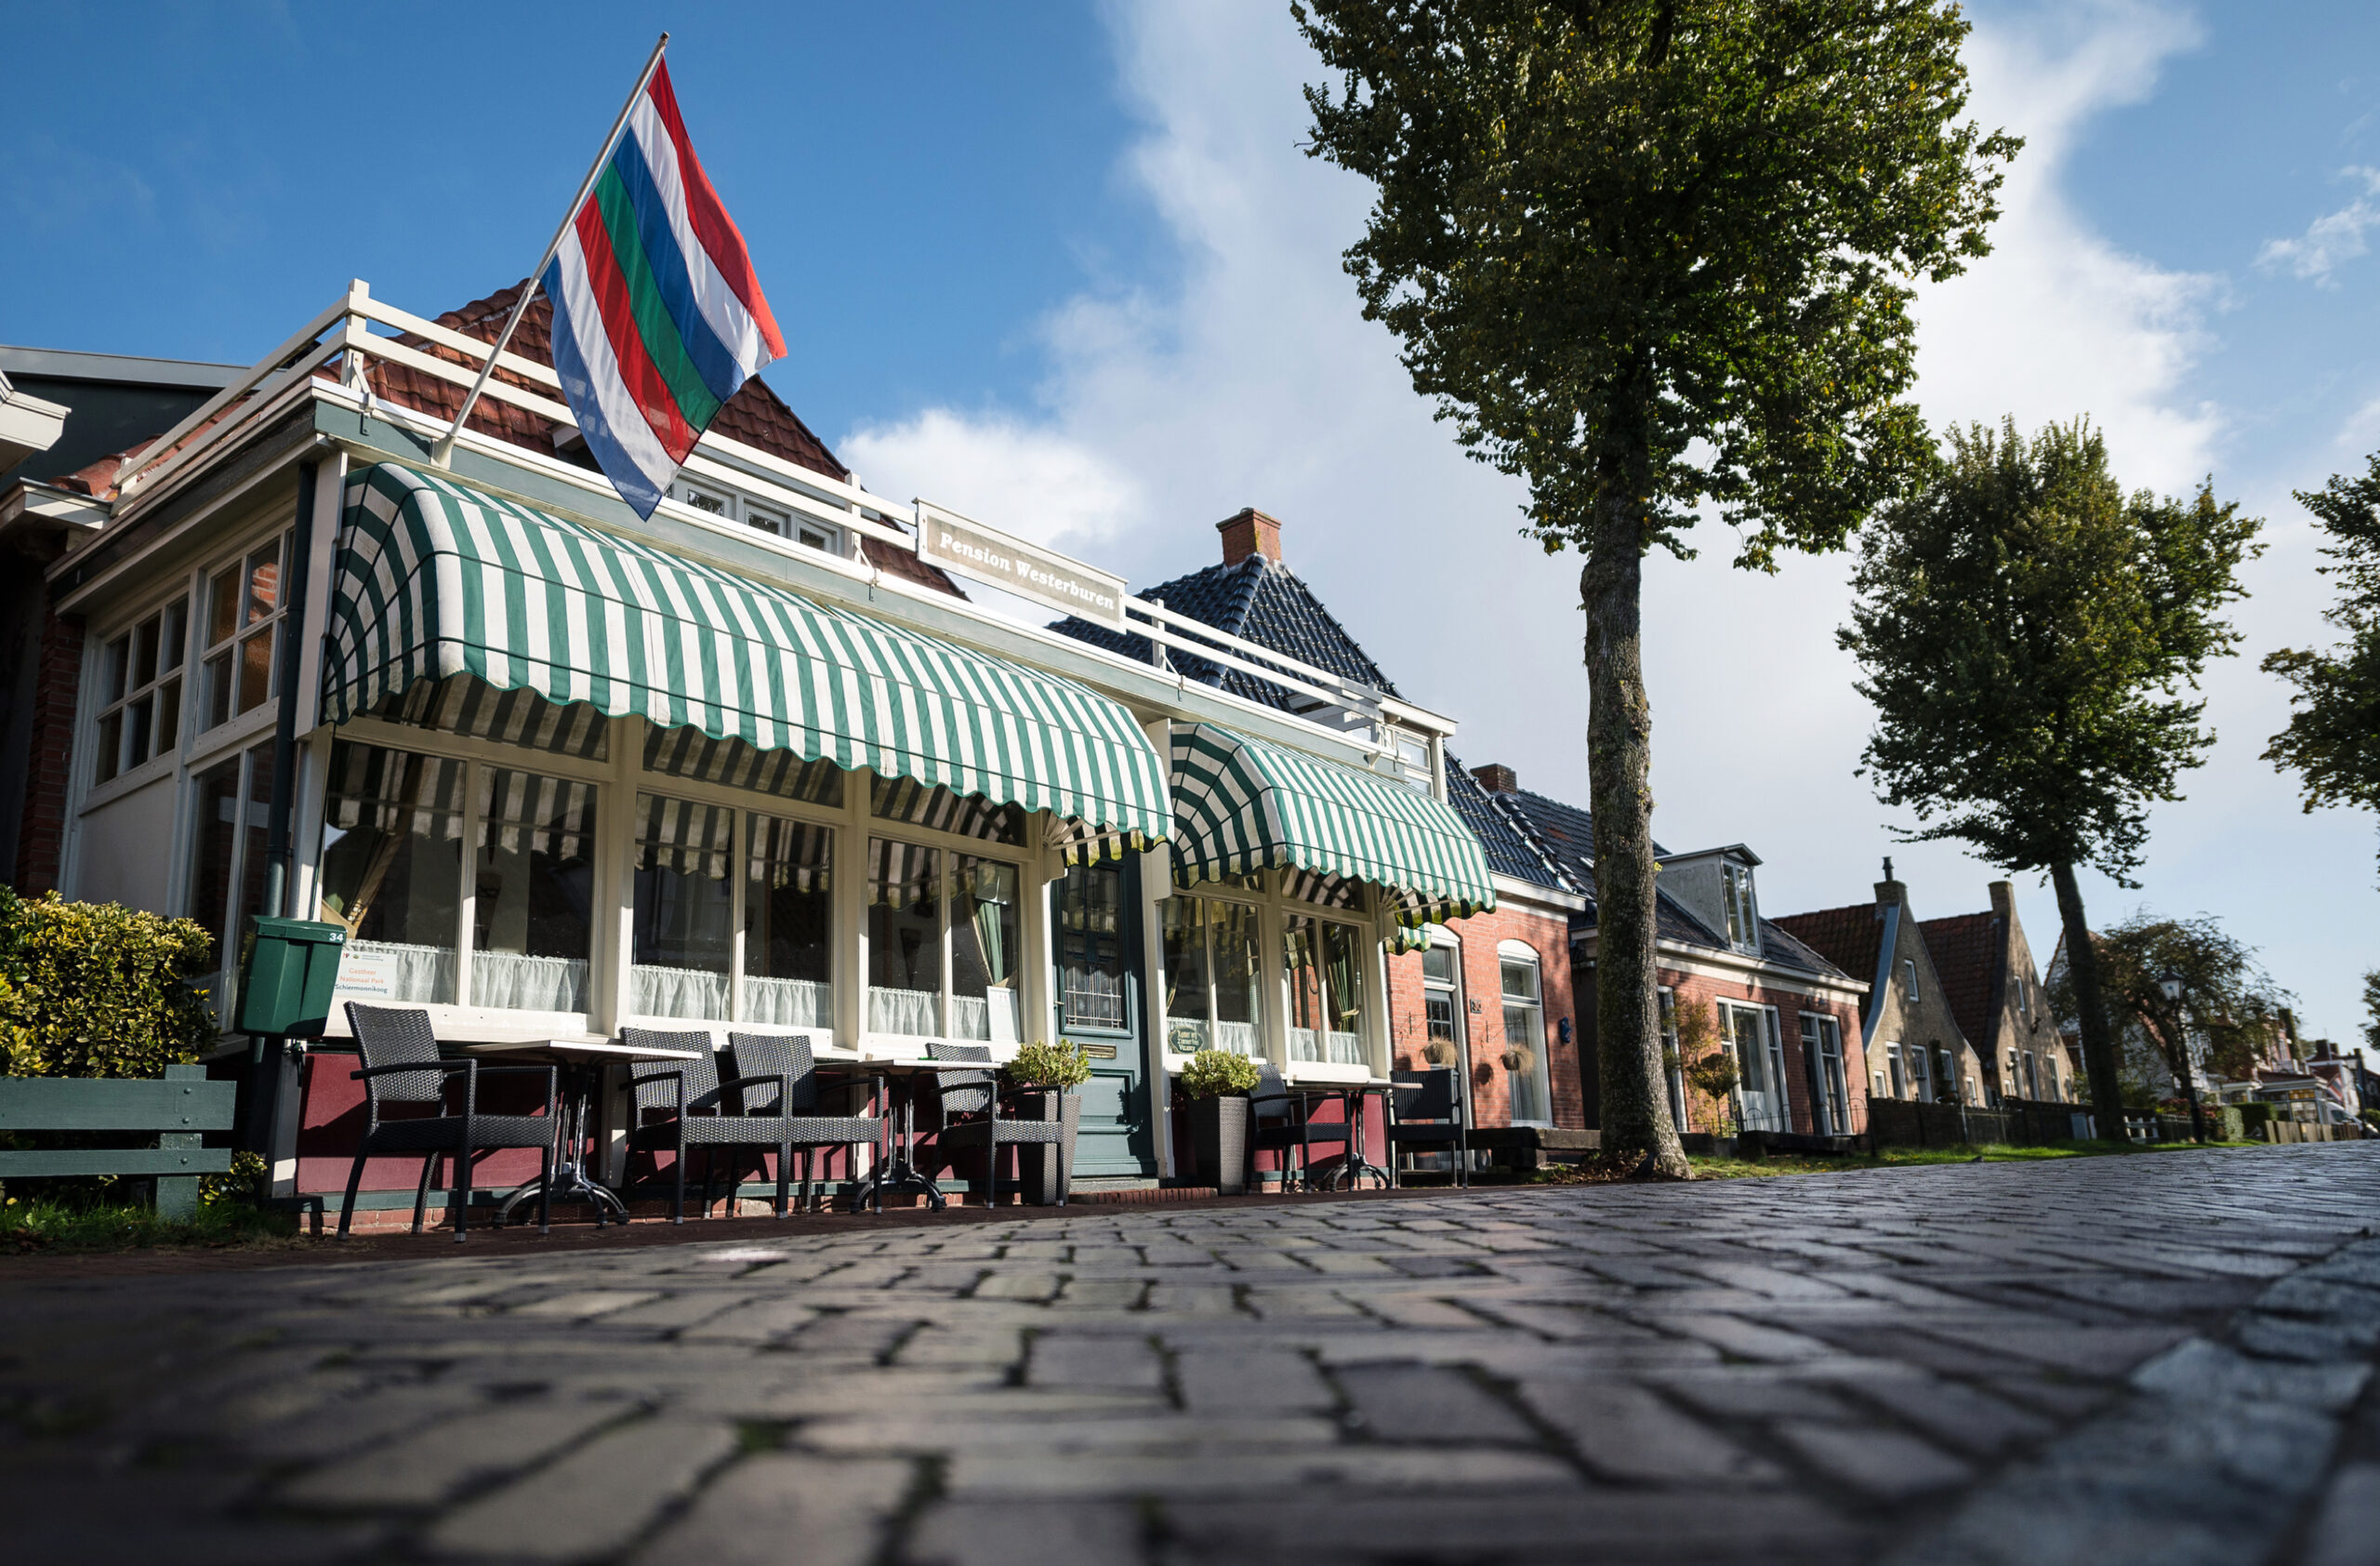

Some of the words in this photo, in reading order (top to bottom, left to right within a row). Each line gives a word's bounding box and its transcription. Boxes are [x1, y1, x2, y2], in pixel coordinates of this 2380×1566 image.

[939, 531, 1012, 572] Pension
[1014, 559, 1115, 610] Westerburen
[329, 933, 344, 941] 34
[349, 967, 377, 975] Gastheer
[335, 984, 388, 994] Schiermonnikoog
